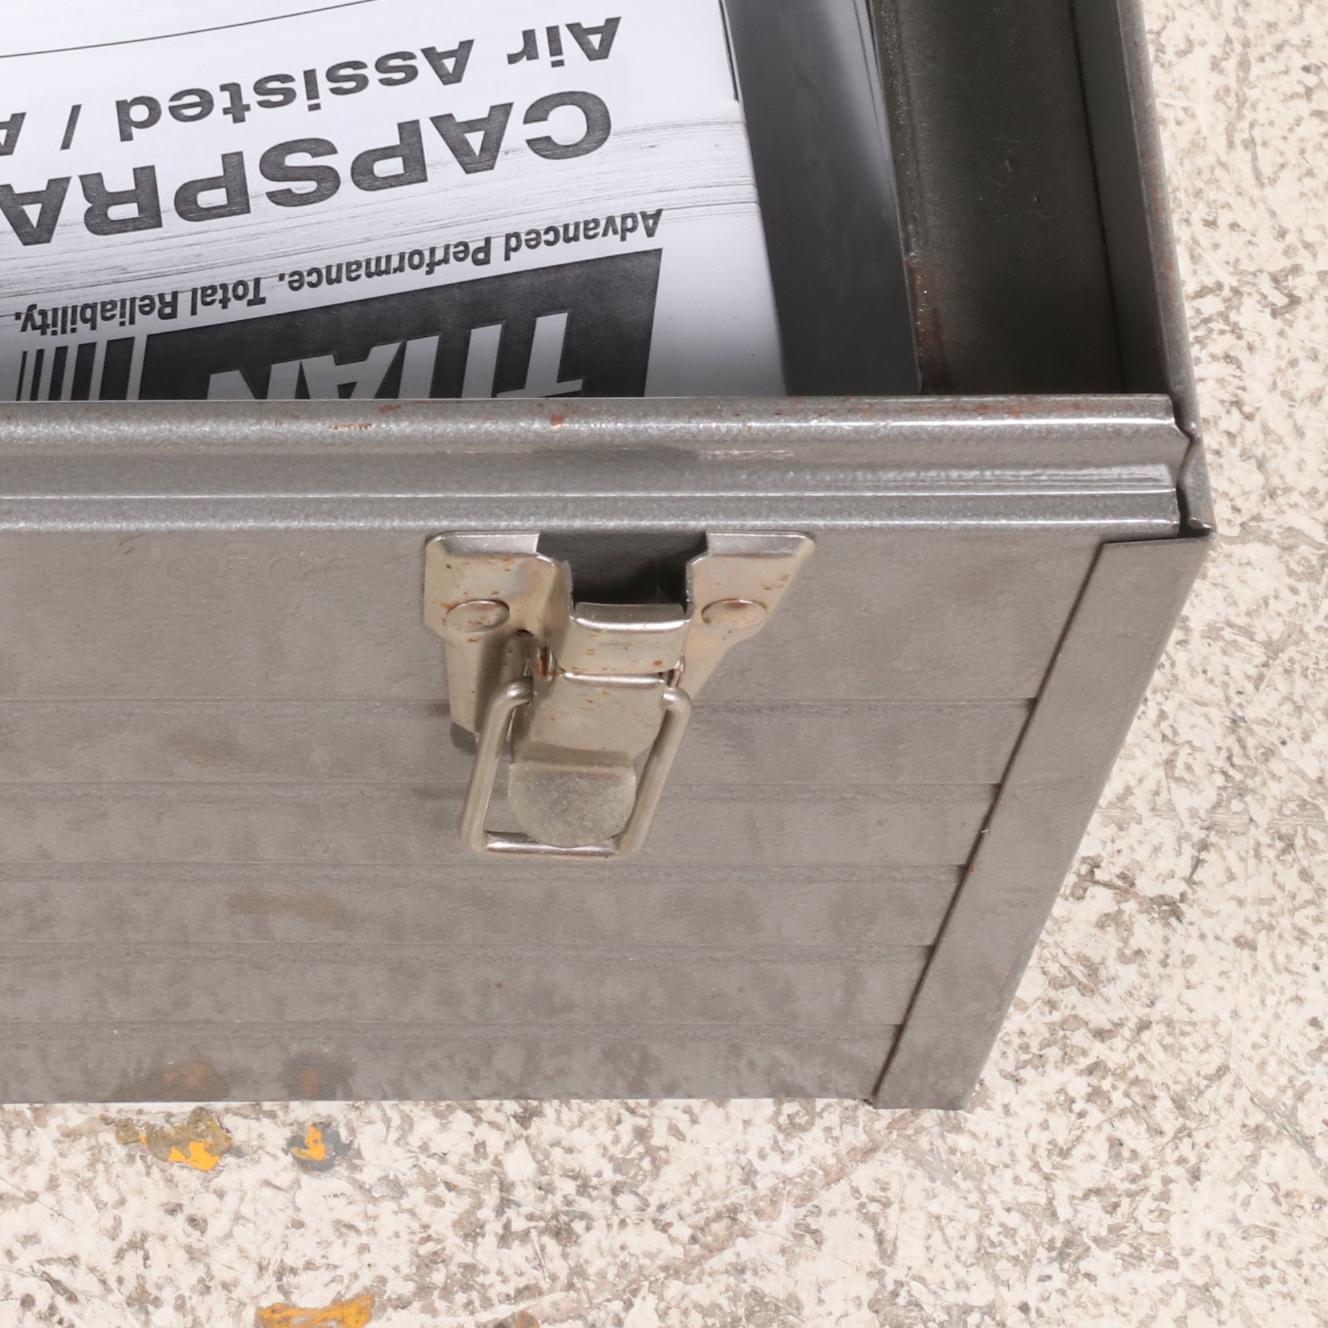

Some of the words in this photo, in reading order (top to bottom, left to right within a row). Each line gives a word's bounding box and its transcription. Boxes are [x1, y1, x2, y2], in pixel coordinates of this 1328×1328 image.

[506, 16, 622, 68] Air
[118, 39, 475, 142] Assisted
[61, 104, 82, 150] /
[503, 208, 663, 262] Advanced
[277, 235, 492, 293] Performance.
[14, 288, 180, 336] Reliability.
[190, 275, 267, 318] Total
